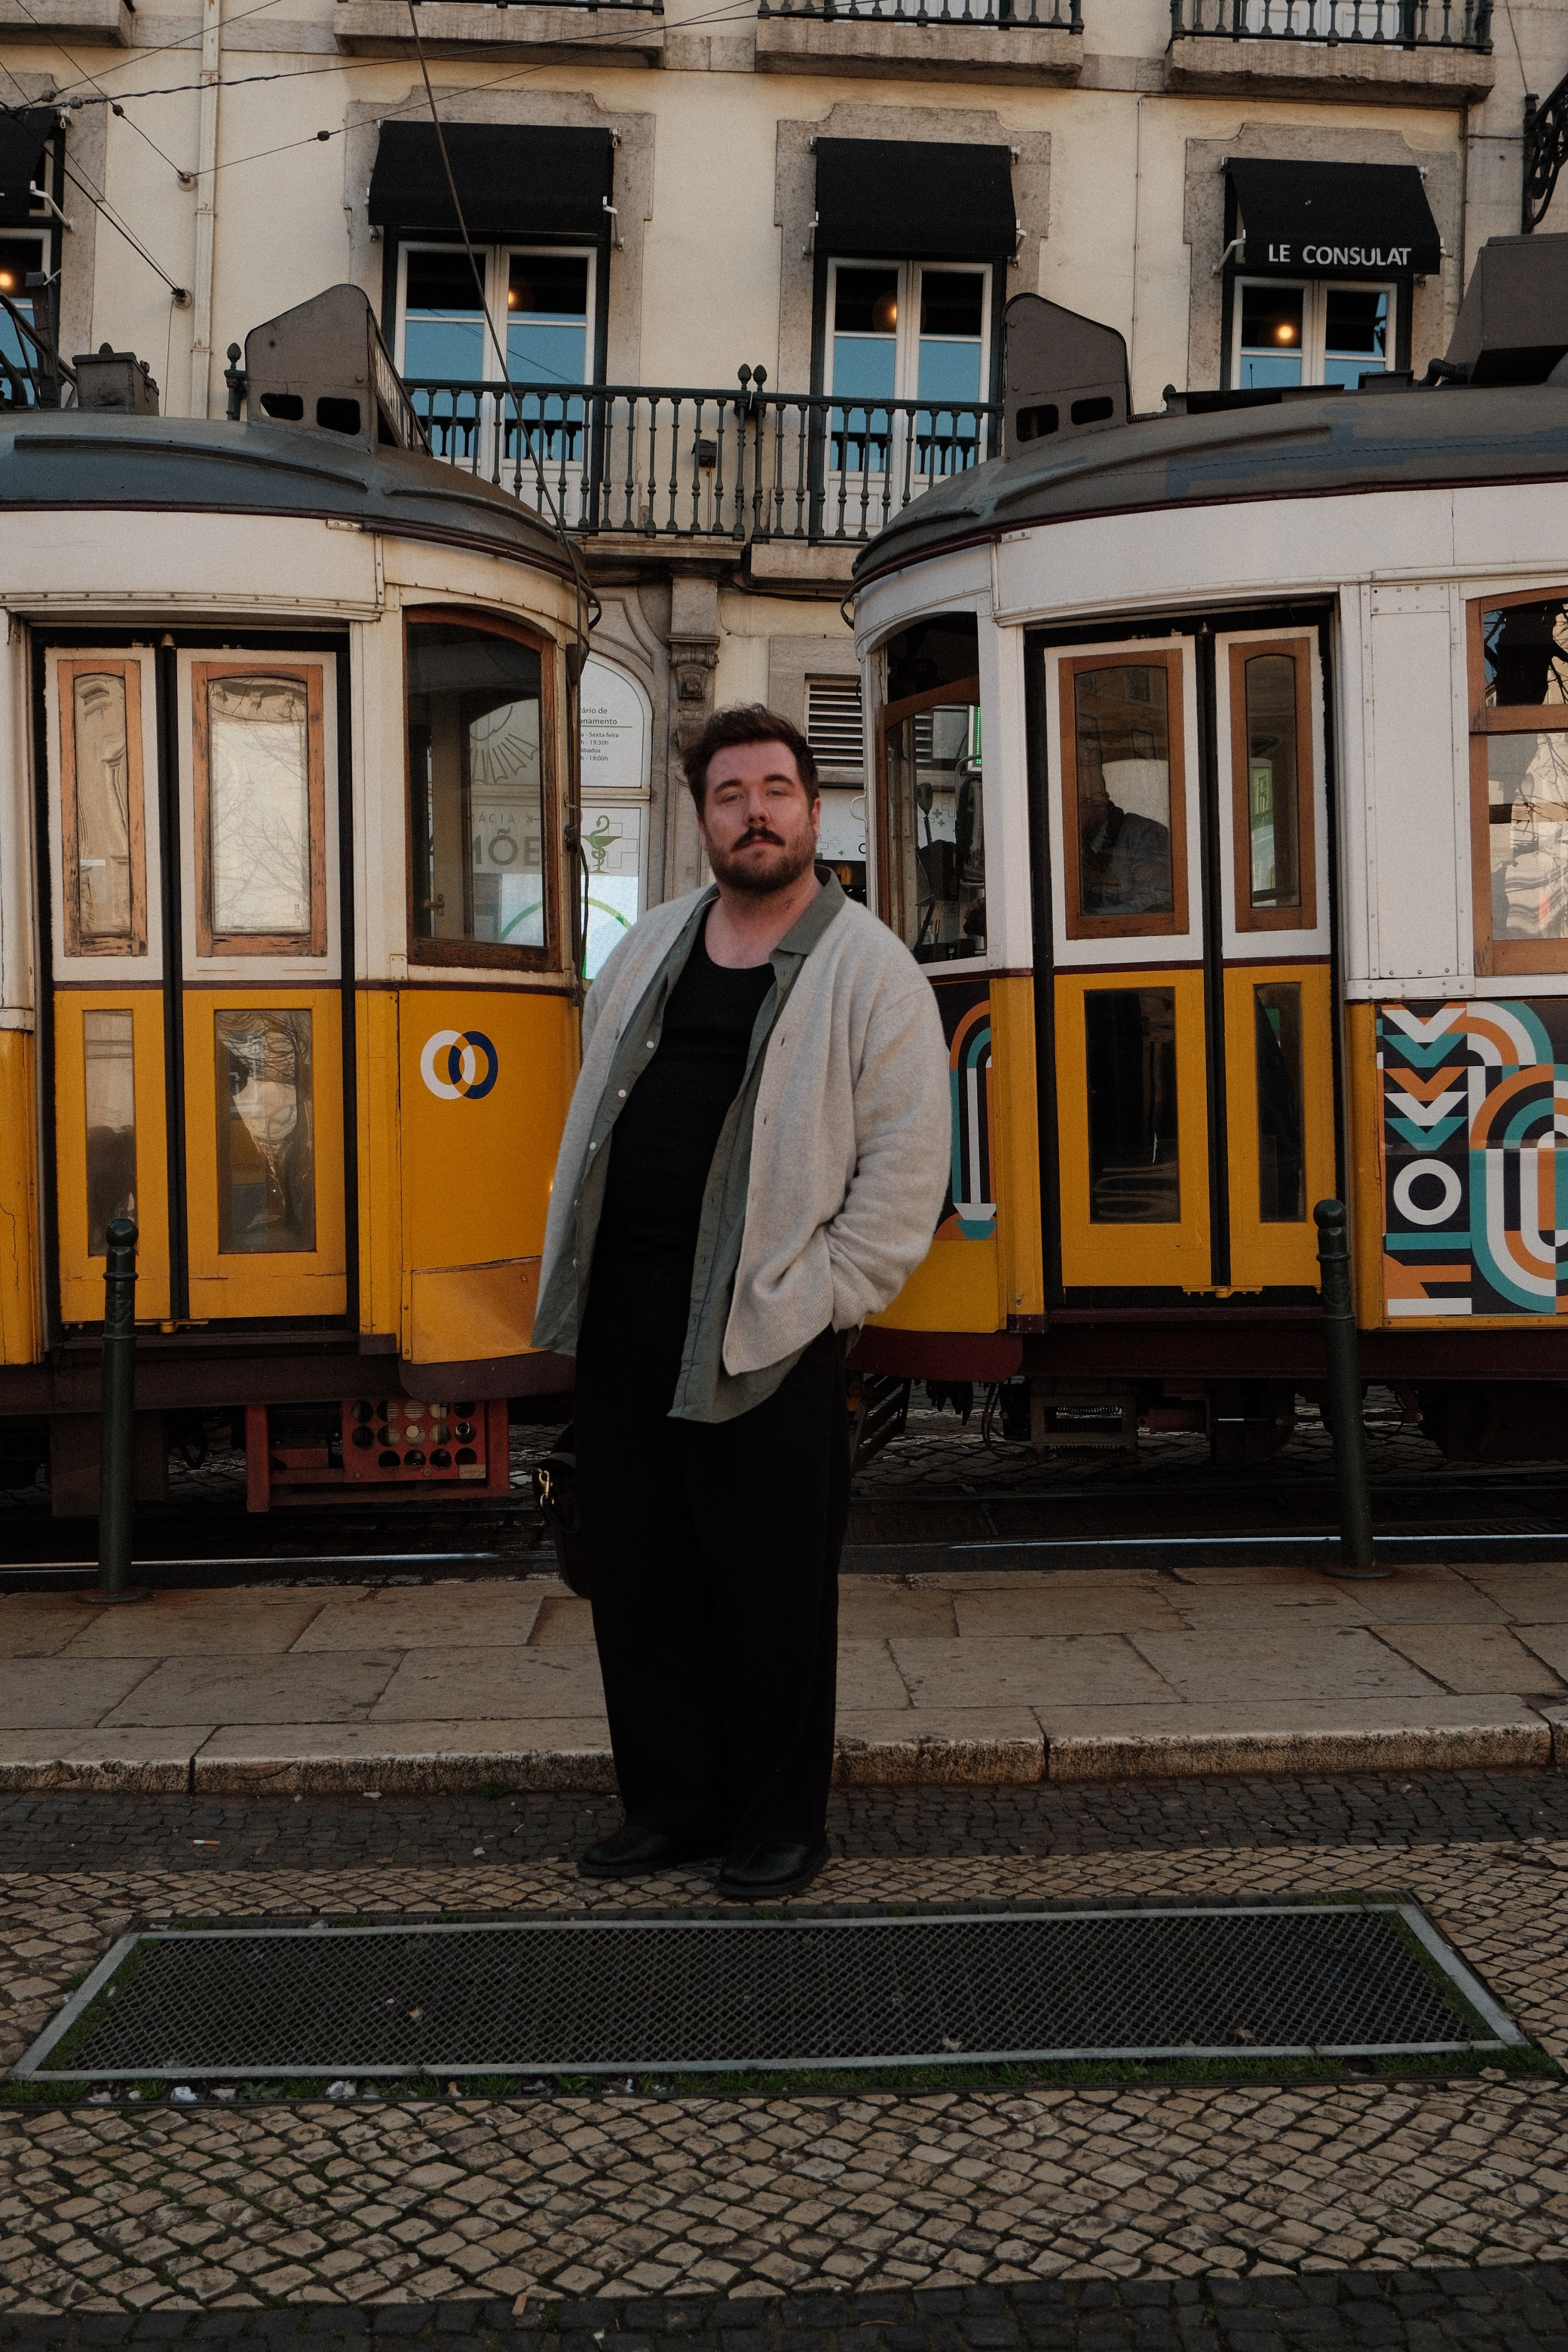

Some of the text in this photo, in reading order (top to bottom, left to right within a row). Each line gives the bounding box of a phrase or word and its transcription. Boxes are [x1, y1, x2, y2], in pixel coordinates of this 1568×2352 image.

[1269, 243, 1412, 265] LE CONSULAT
[473, 811, 516, 823] ÁCIA
